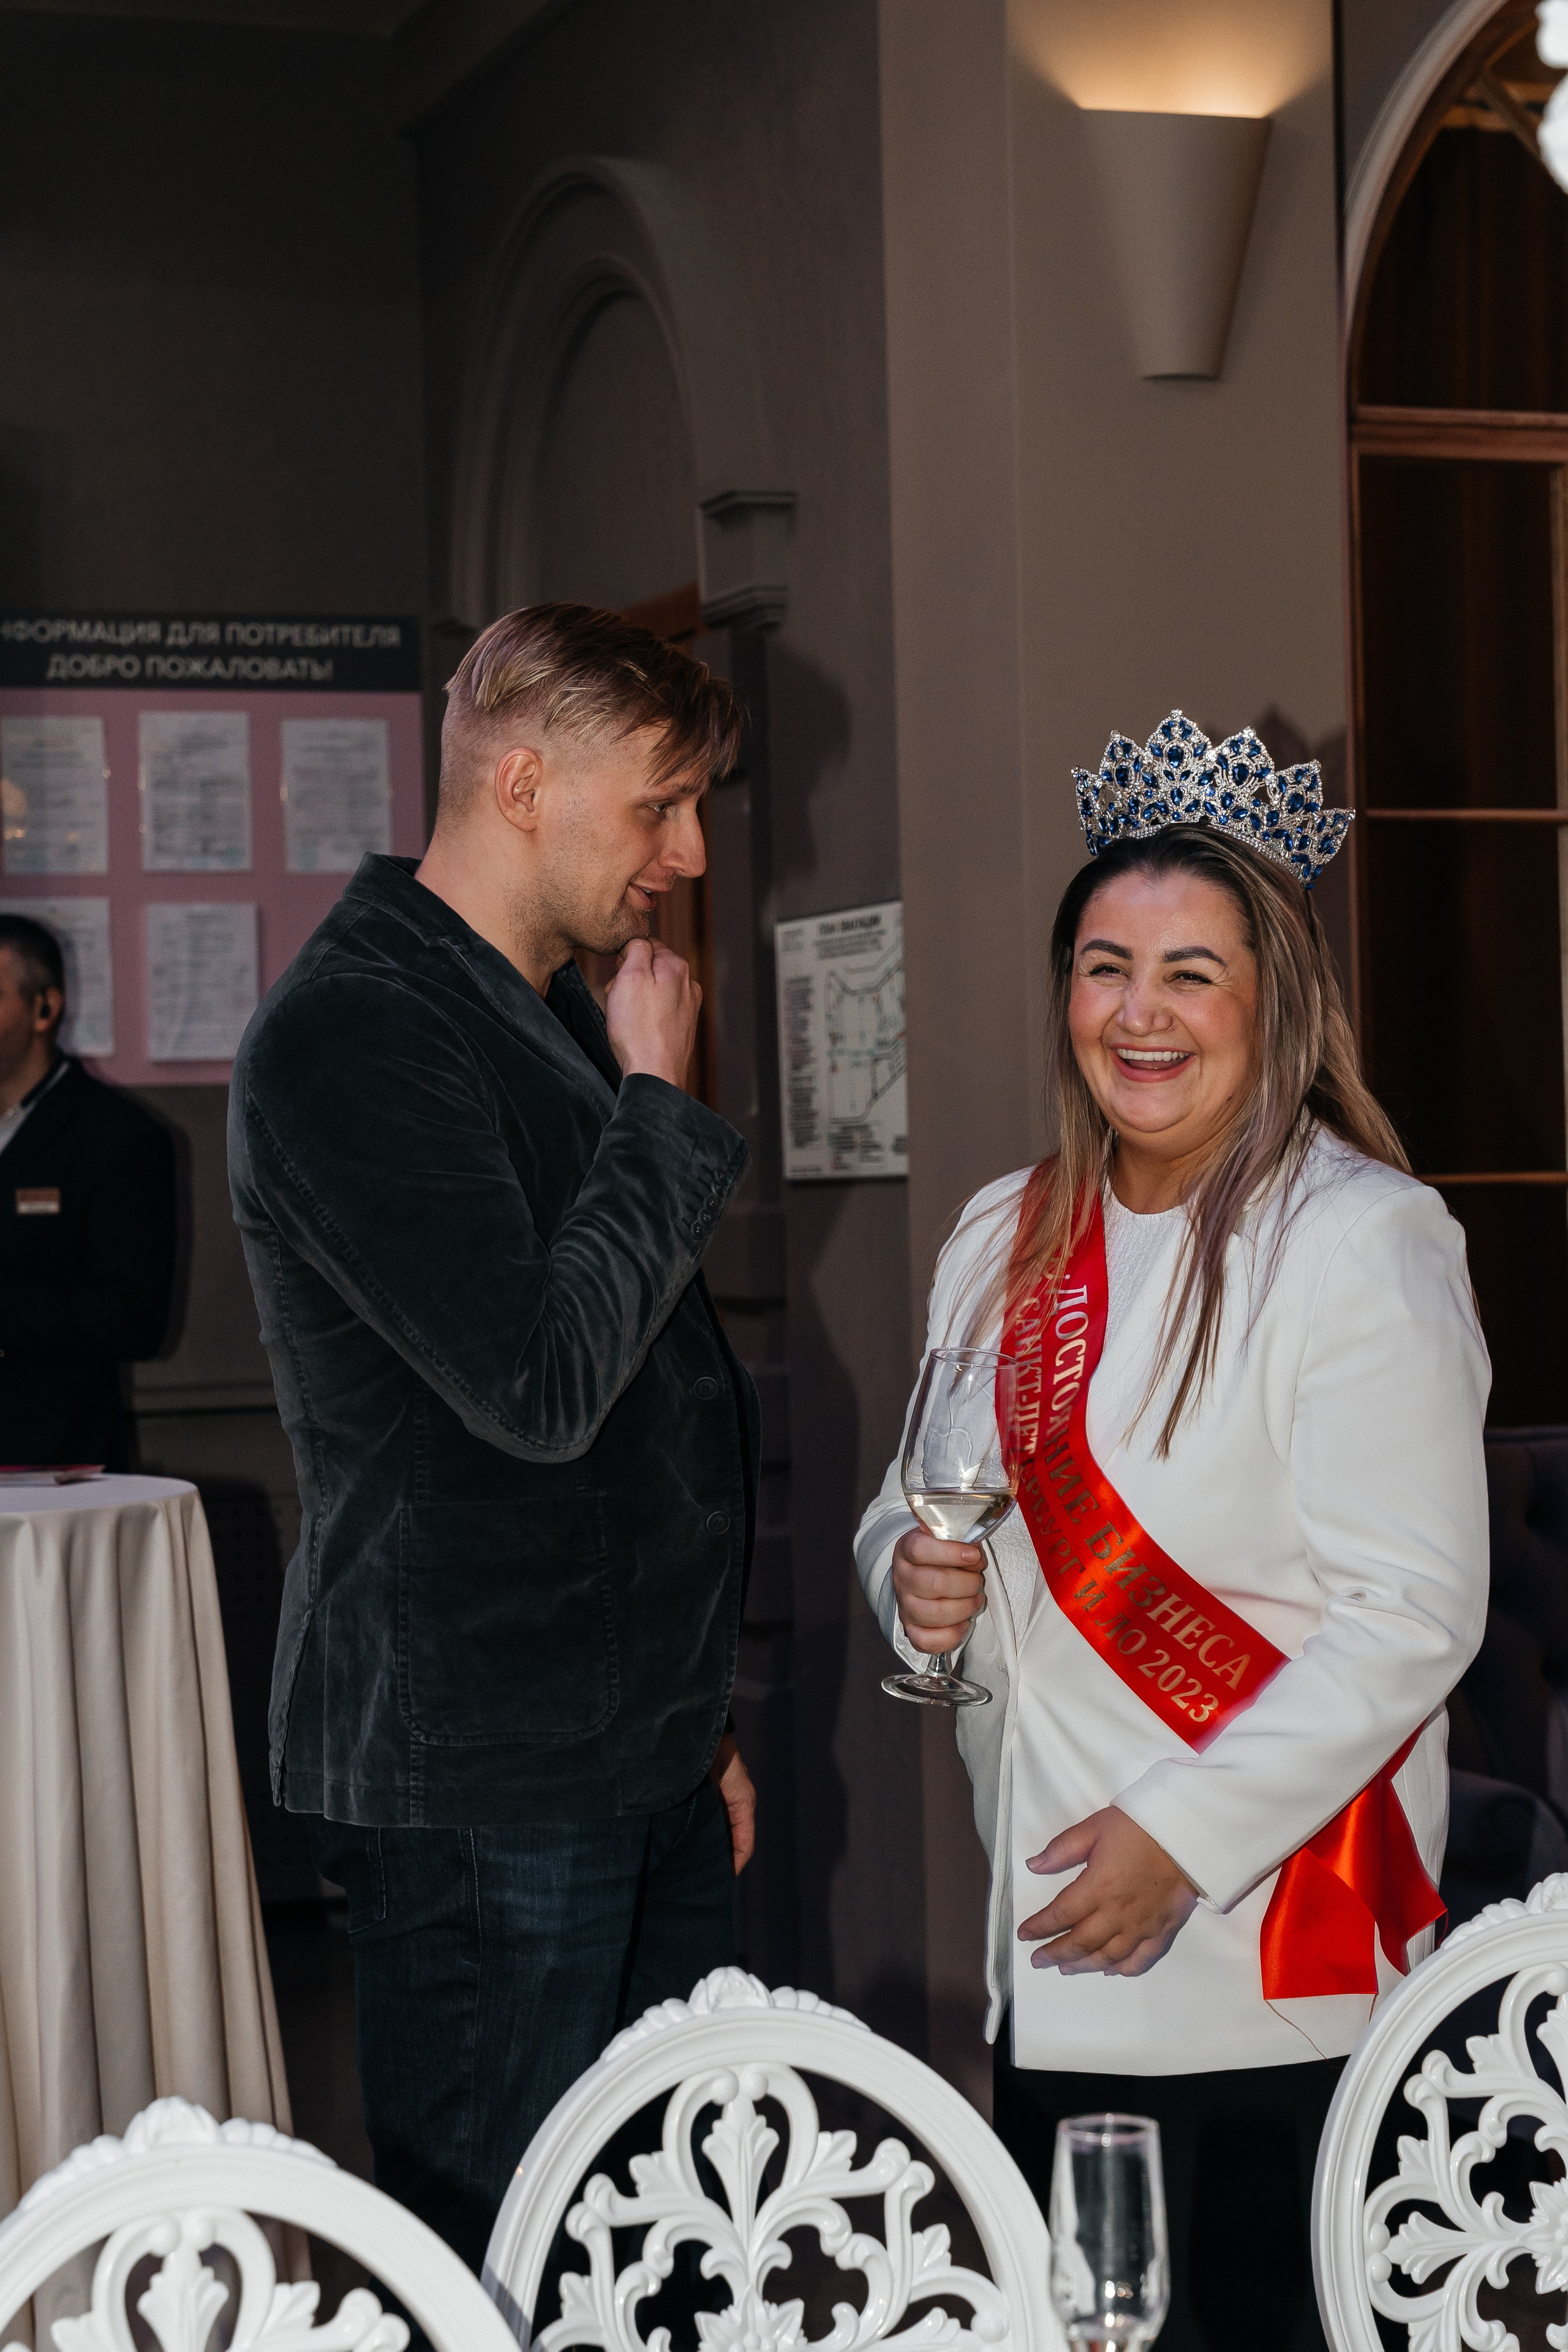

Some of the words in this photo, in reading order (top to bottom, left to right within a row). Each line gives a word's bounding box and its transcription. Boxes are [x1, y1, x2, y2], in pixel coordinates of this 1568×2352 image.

[45, 652, 143, 681] ДОБРО
[165, 620, 221, 647] ДЛЯ
[224, 621, 401, 648] ПОТРЕБИТЕЛЯ
[1044, 1284, 1100, 1525] ДОСТОЯНИЕ
[1084, 1520, 1251, 1691] БИЗНЕСА
[1072, 1578, 1109, 1613] И
[1095, 1612, 1147, 1656] ЛО
[1137, 1649, 1219, 1722] 2023
